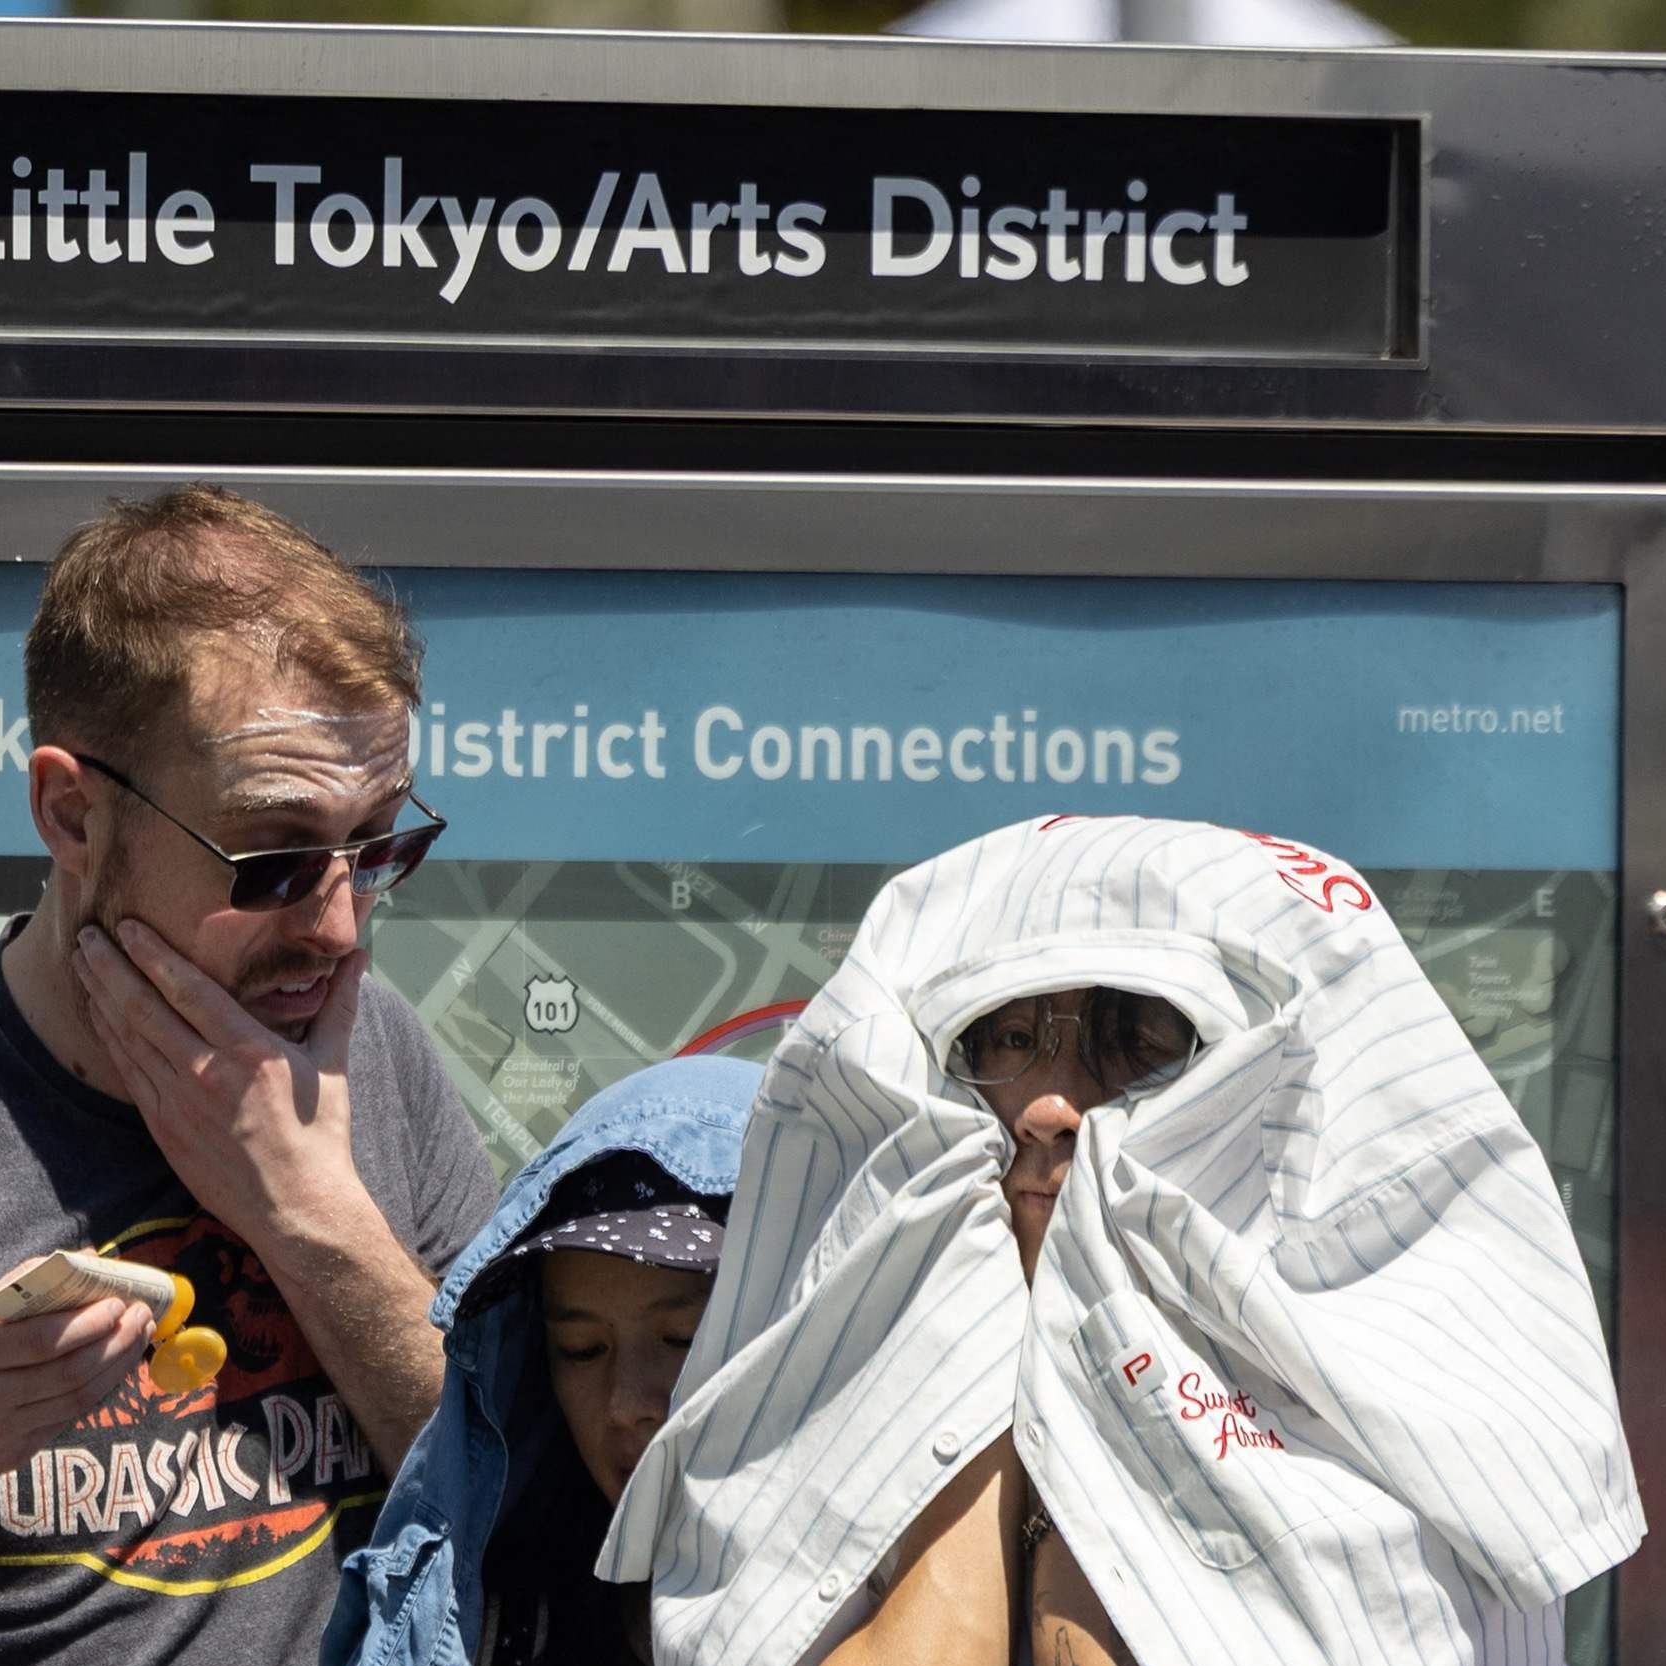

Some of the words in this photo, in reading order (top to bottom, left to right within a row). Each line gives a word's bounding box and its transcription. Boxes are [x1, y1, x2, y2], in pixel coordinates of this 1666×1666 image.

[250, 163, 827, 304] Tokyo/Arts
[870, 173, 1248, 288] District
[1397, 703, 1566, 736] metro.net
[693, 704, 1182, 787] Connections
[671, 881, 692, 911] B
[1535, 889, 1556, 918] E
[532, 1000, 570, 1022] 101
[502, 1059, 565, 1073] Cathedral
[567, 1059, 582, 1075] of
[502, 1076, 528, 1090] Our
[530, 1076, 562, 1091] Lady
[564, 1076, 580, 1091] of
[502, 1091, 523, 1105] the
[525, 1091, 568, 1109] Angels
[1122, 1352, 1153, 1387] P
[1213, 1412, 1286, 1461] Arms
